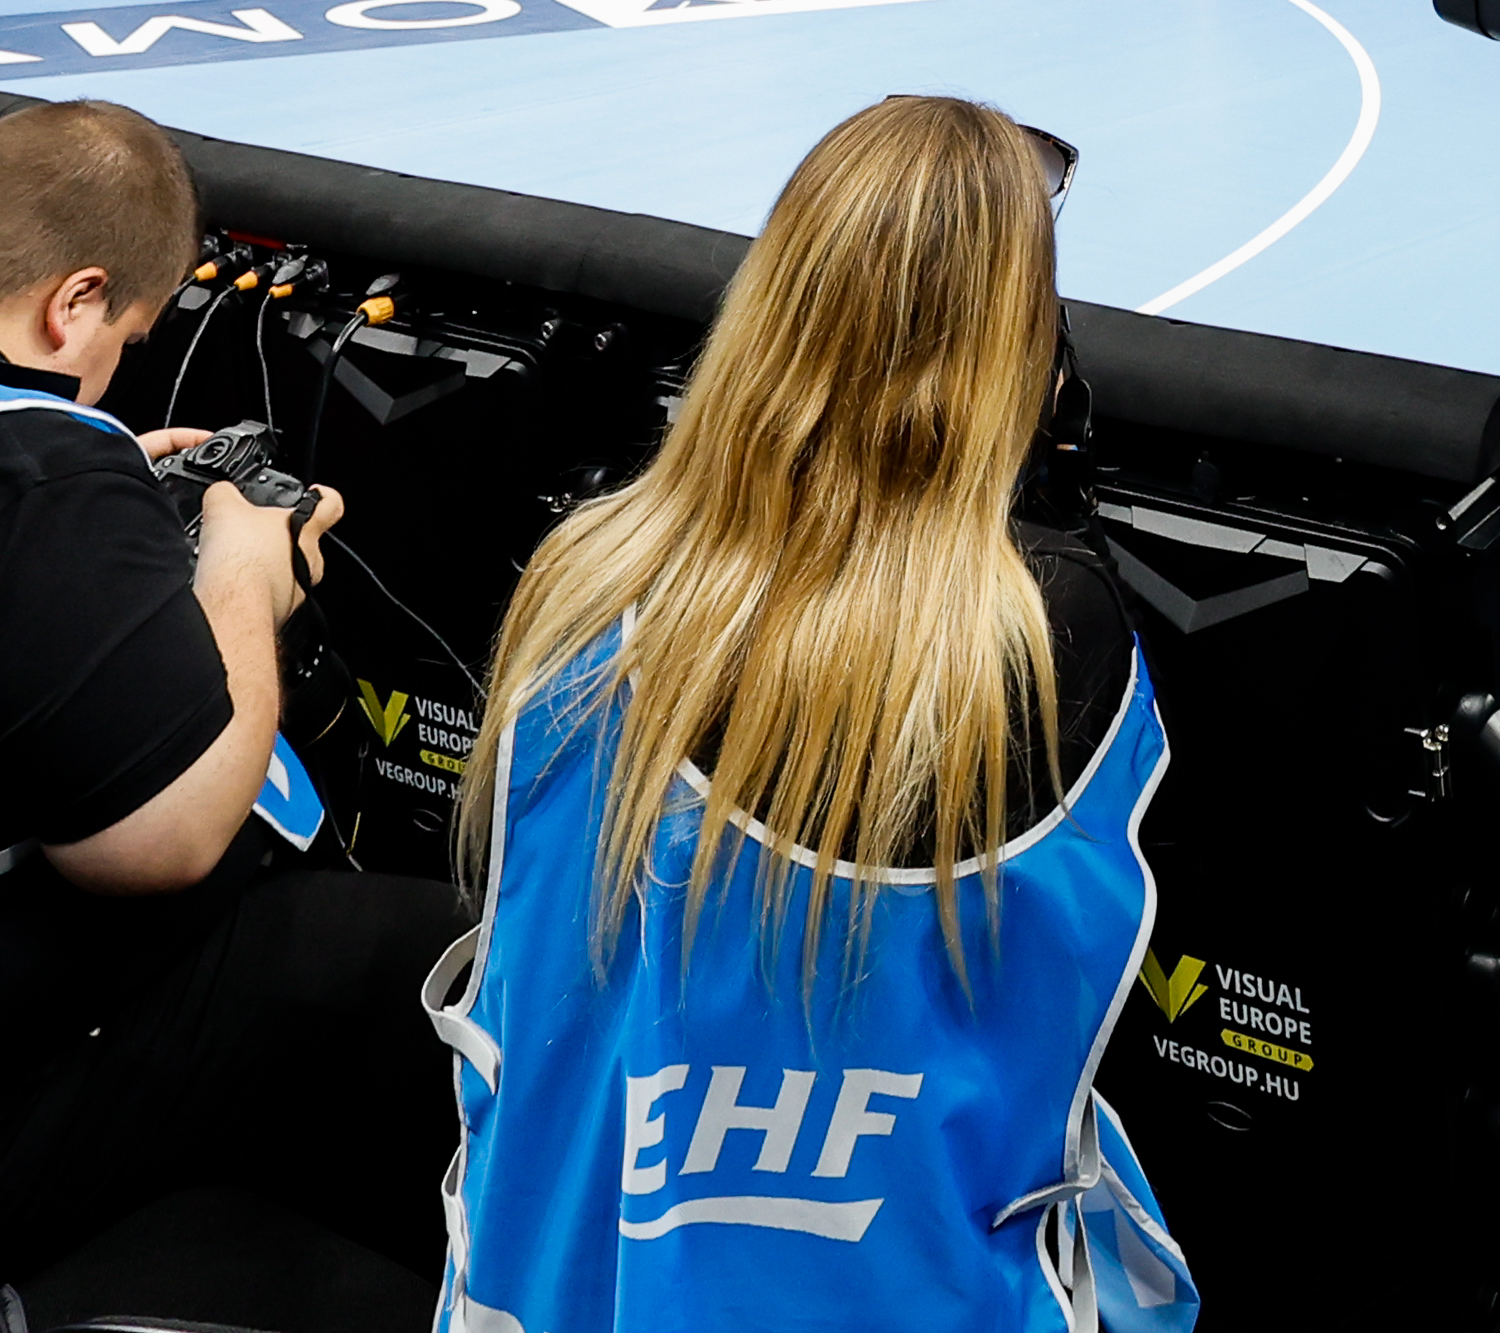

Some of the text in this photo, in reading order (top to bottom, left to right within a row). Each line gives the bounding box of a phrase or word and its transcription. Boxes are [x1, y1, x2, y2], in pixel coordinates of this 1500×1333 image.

[415, 696, 480, 733] VISUAL
[1215, 964, 1310, 1015] VISUAL
[1218, 997, 1312, 1045] EUROPE
[1153, 1035, 1300, 1102] VEGROUP.HU
[1231, 1033, 1303, 1067] GROUP
[622, 1064, 924, 1195] EHF
